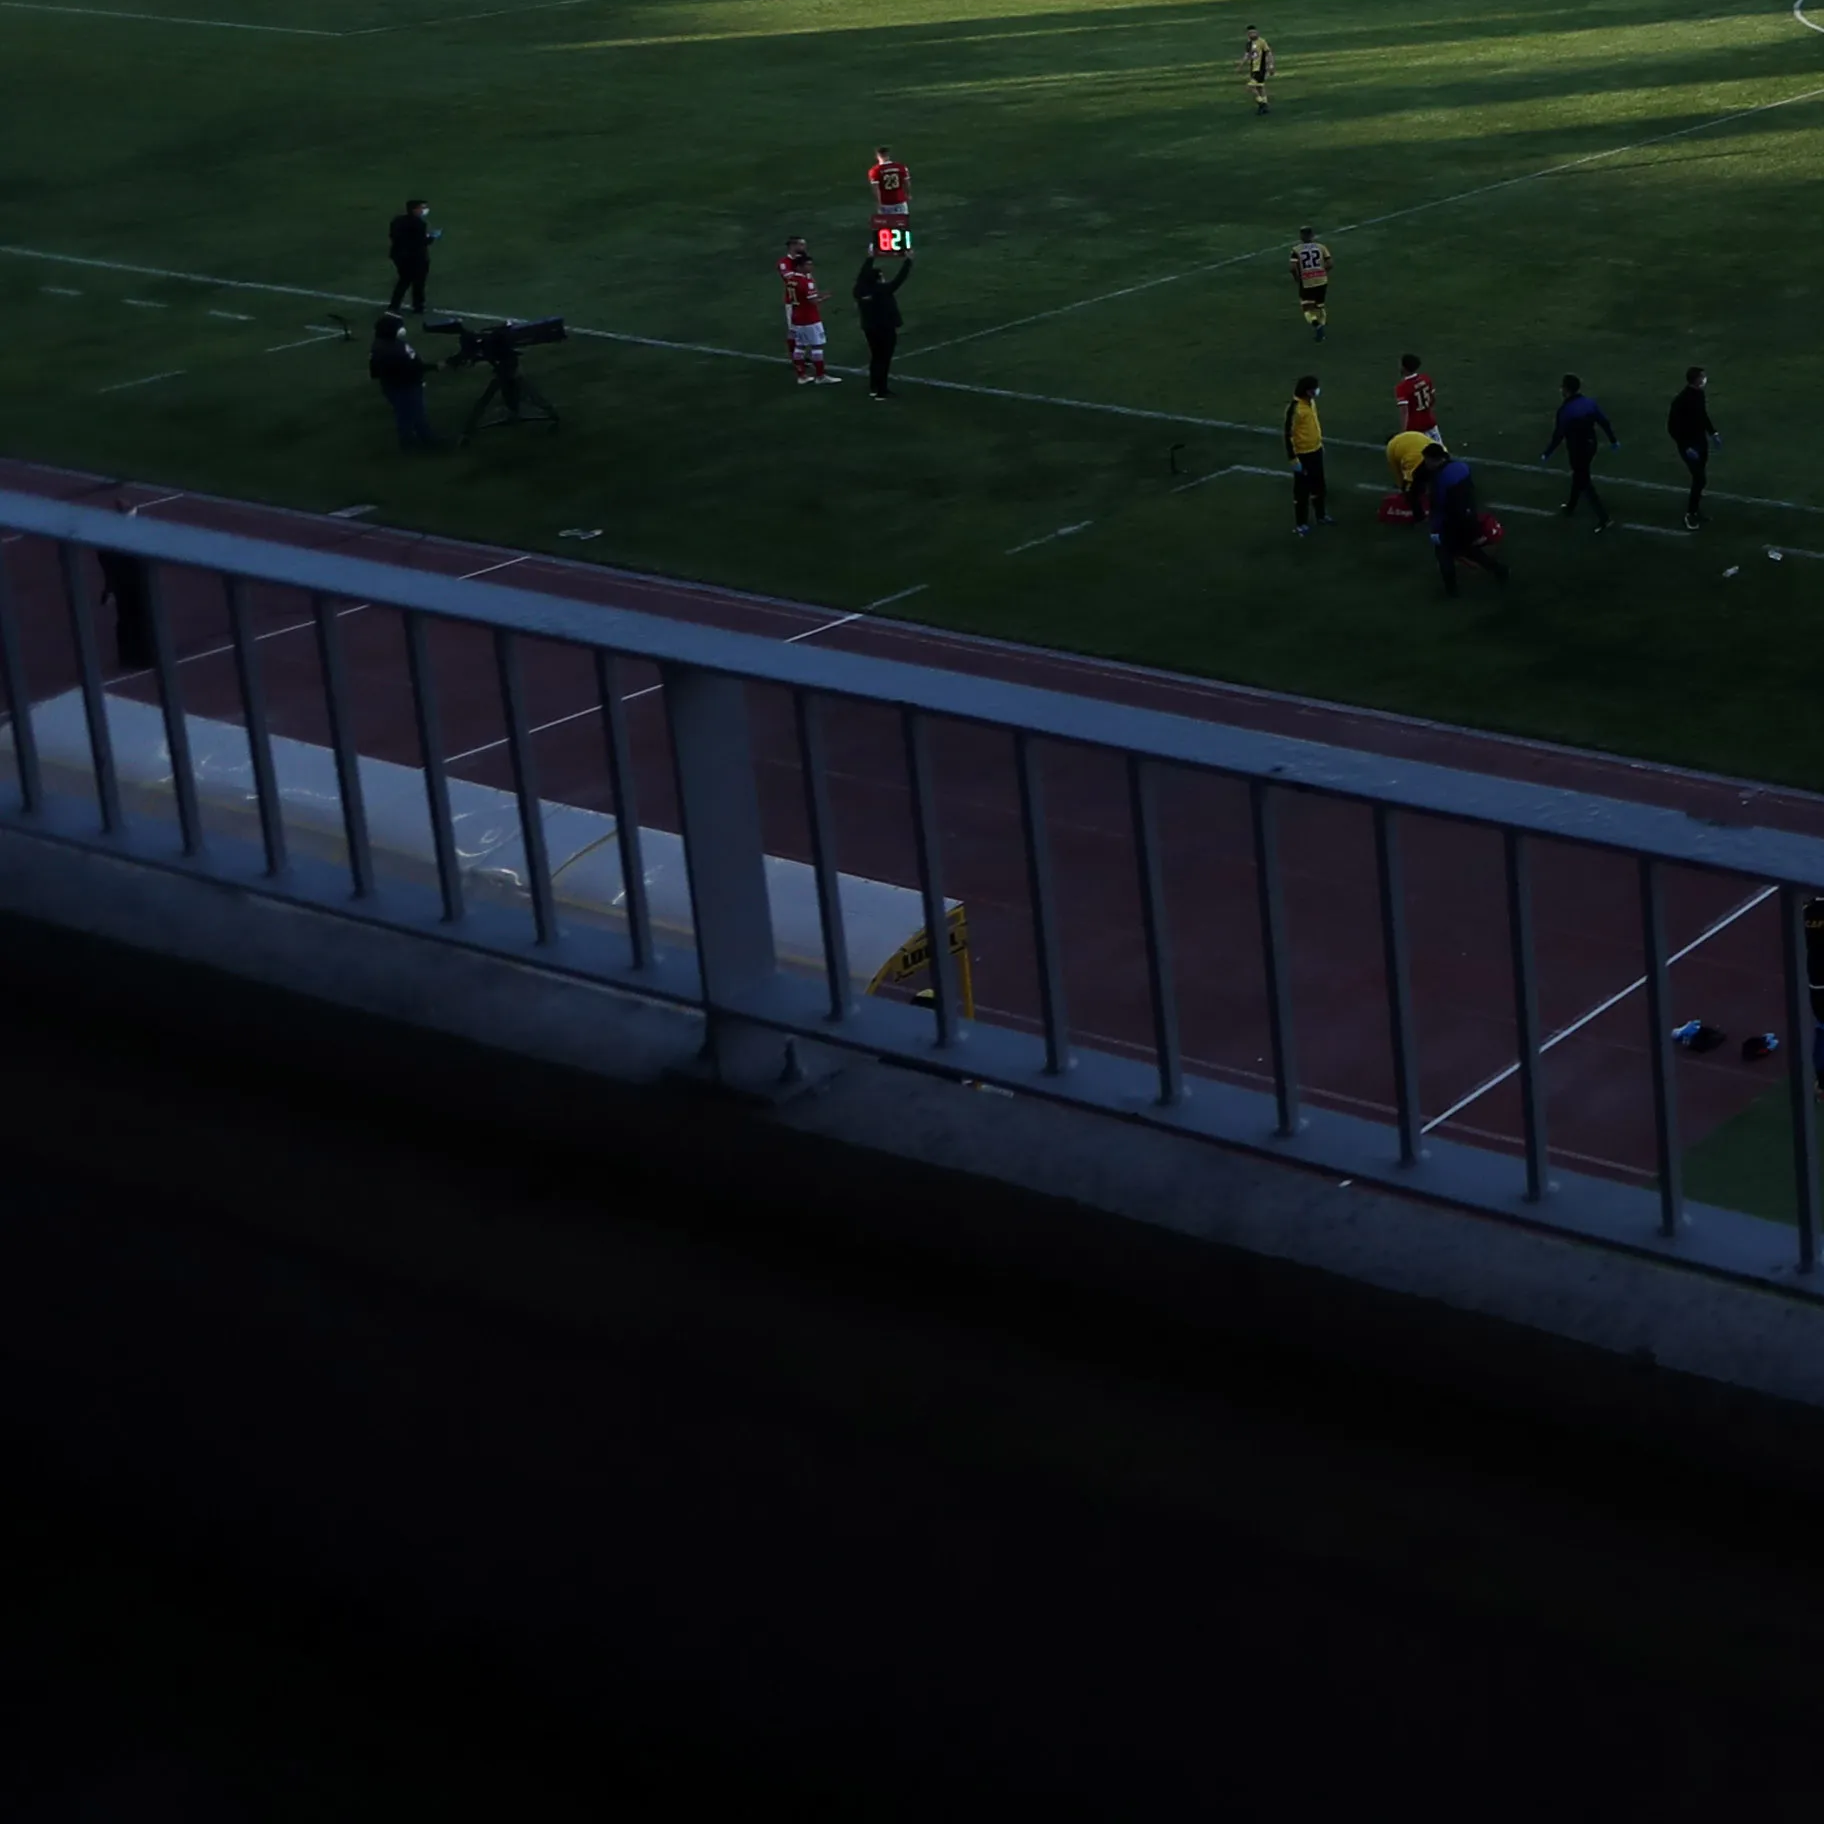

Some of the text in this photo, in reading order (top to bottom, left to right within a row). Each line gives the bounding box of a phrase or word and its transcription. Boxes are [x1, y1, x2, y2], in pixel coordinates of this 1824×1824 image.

[883, 173, 900, 190] 23
[891, 229, 911, 251] 21
[1301, 249, 1321, 268] 22
[1414, 385, 1430, 411] 15
